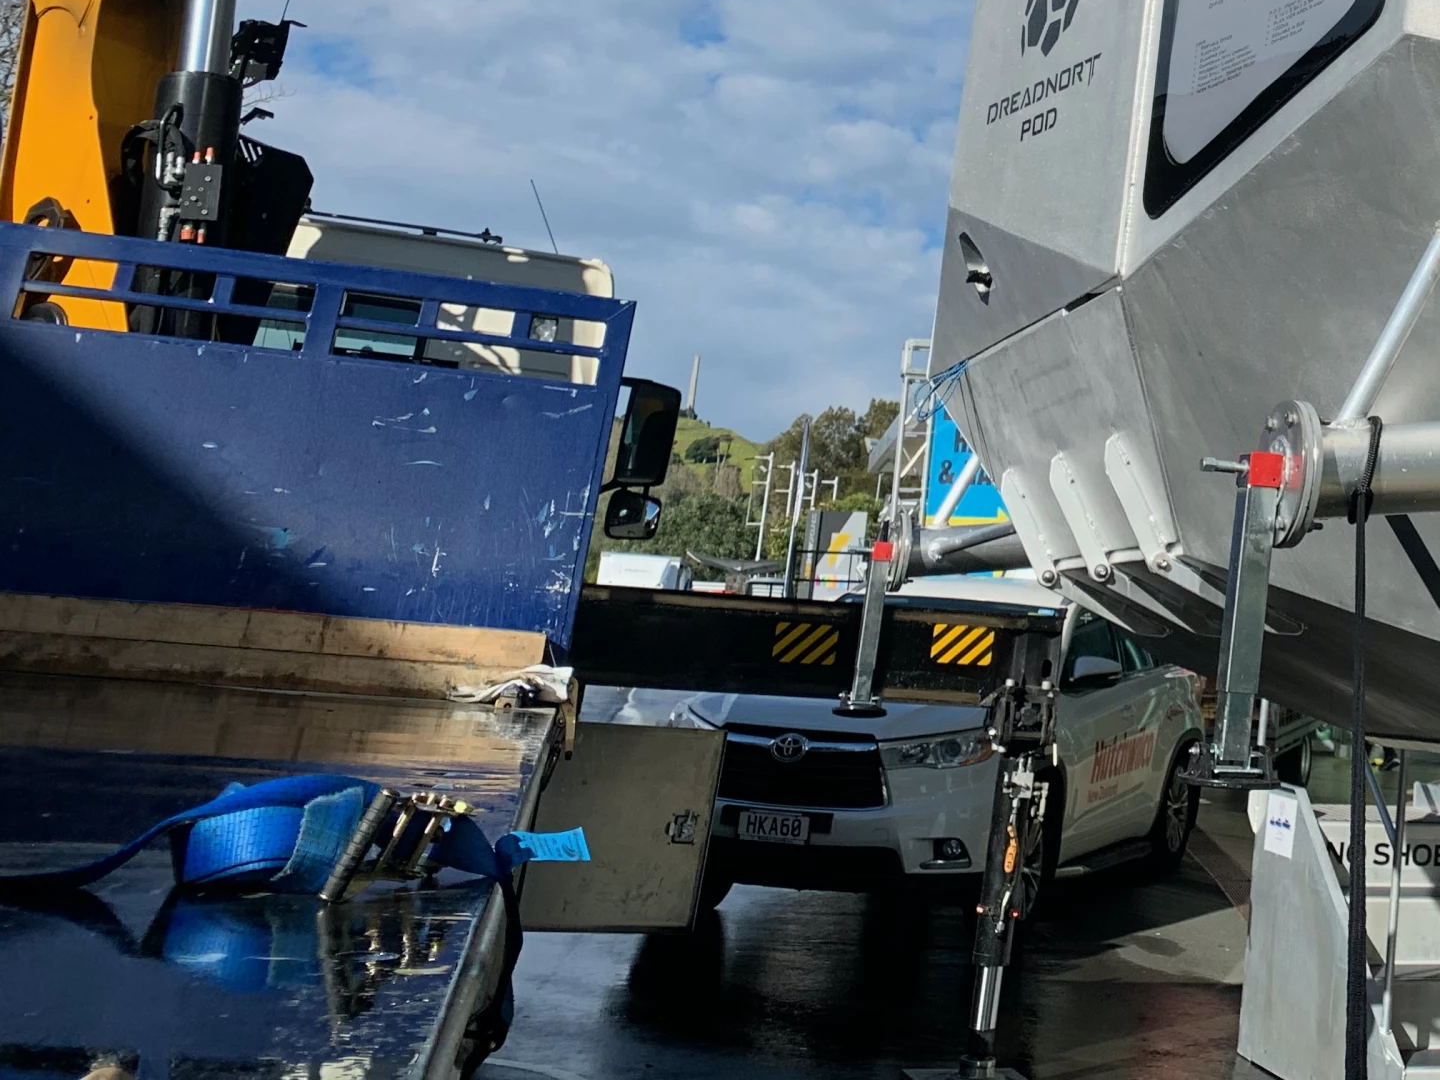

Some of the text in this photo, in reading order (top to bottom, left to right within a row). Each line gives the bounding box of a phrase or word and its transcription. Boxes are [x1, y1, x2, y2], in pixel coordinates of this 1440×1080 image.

[986, 52, 1103, 126] DREADNORT
[1020, 107, 1058, 143] POD
[745, 814, 802, 838] HKA60
